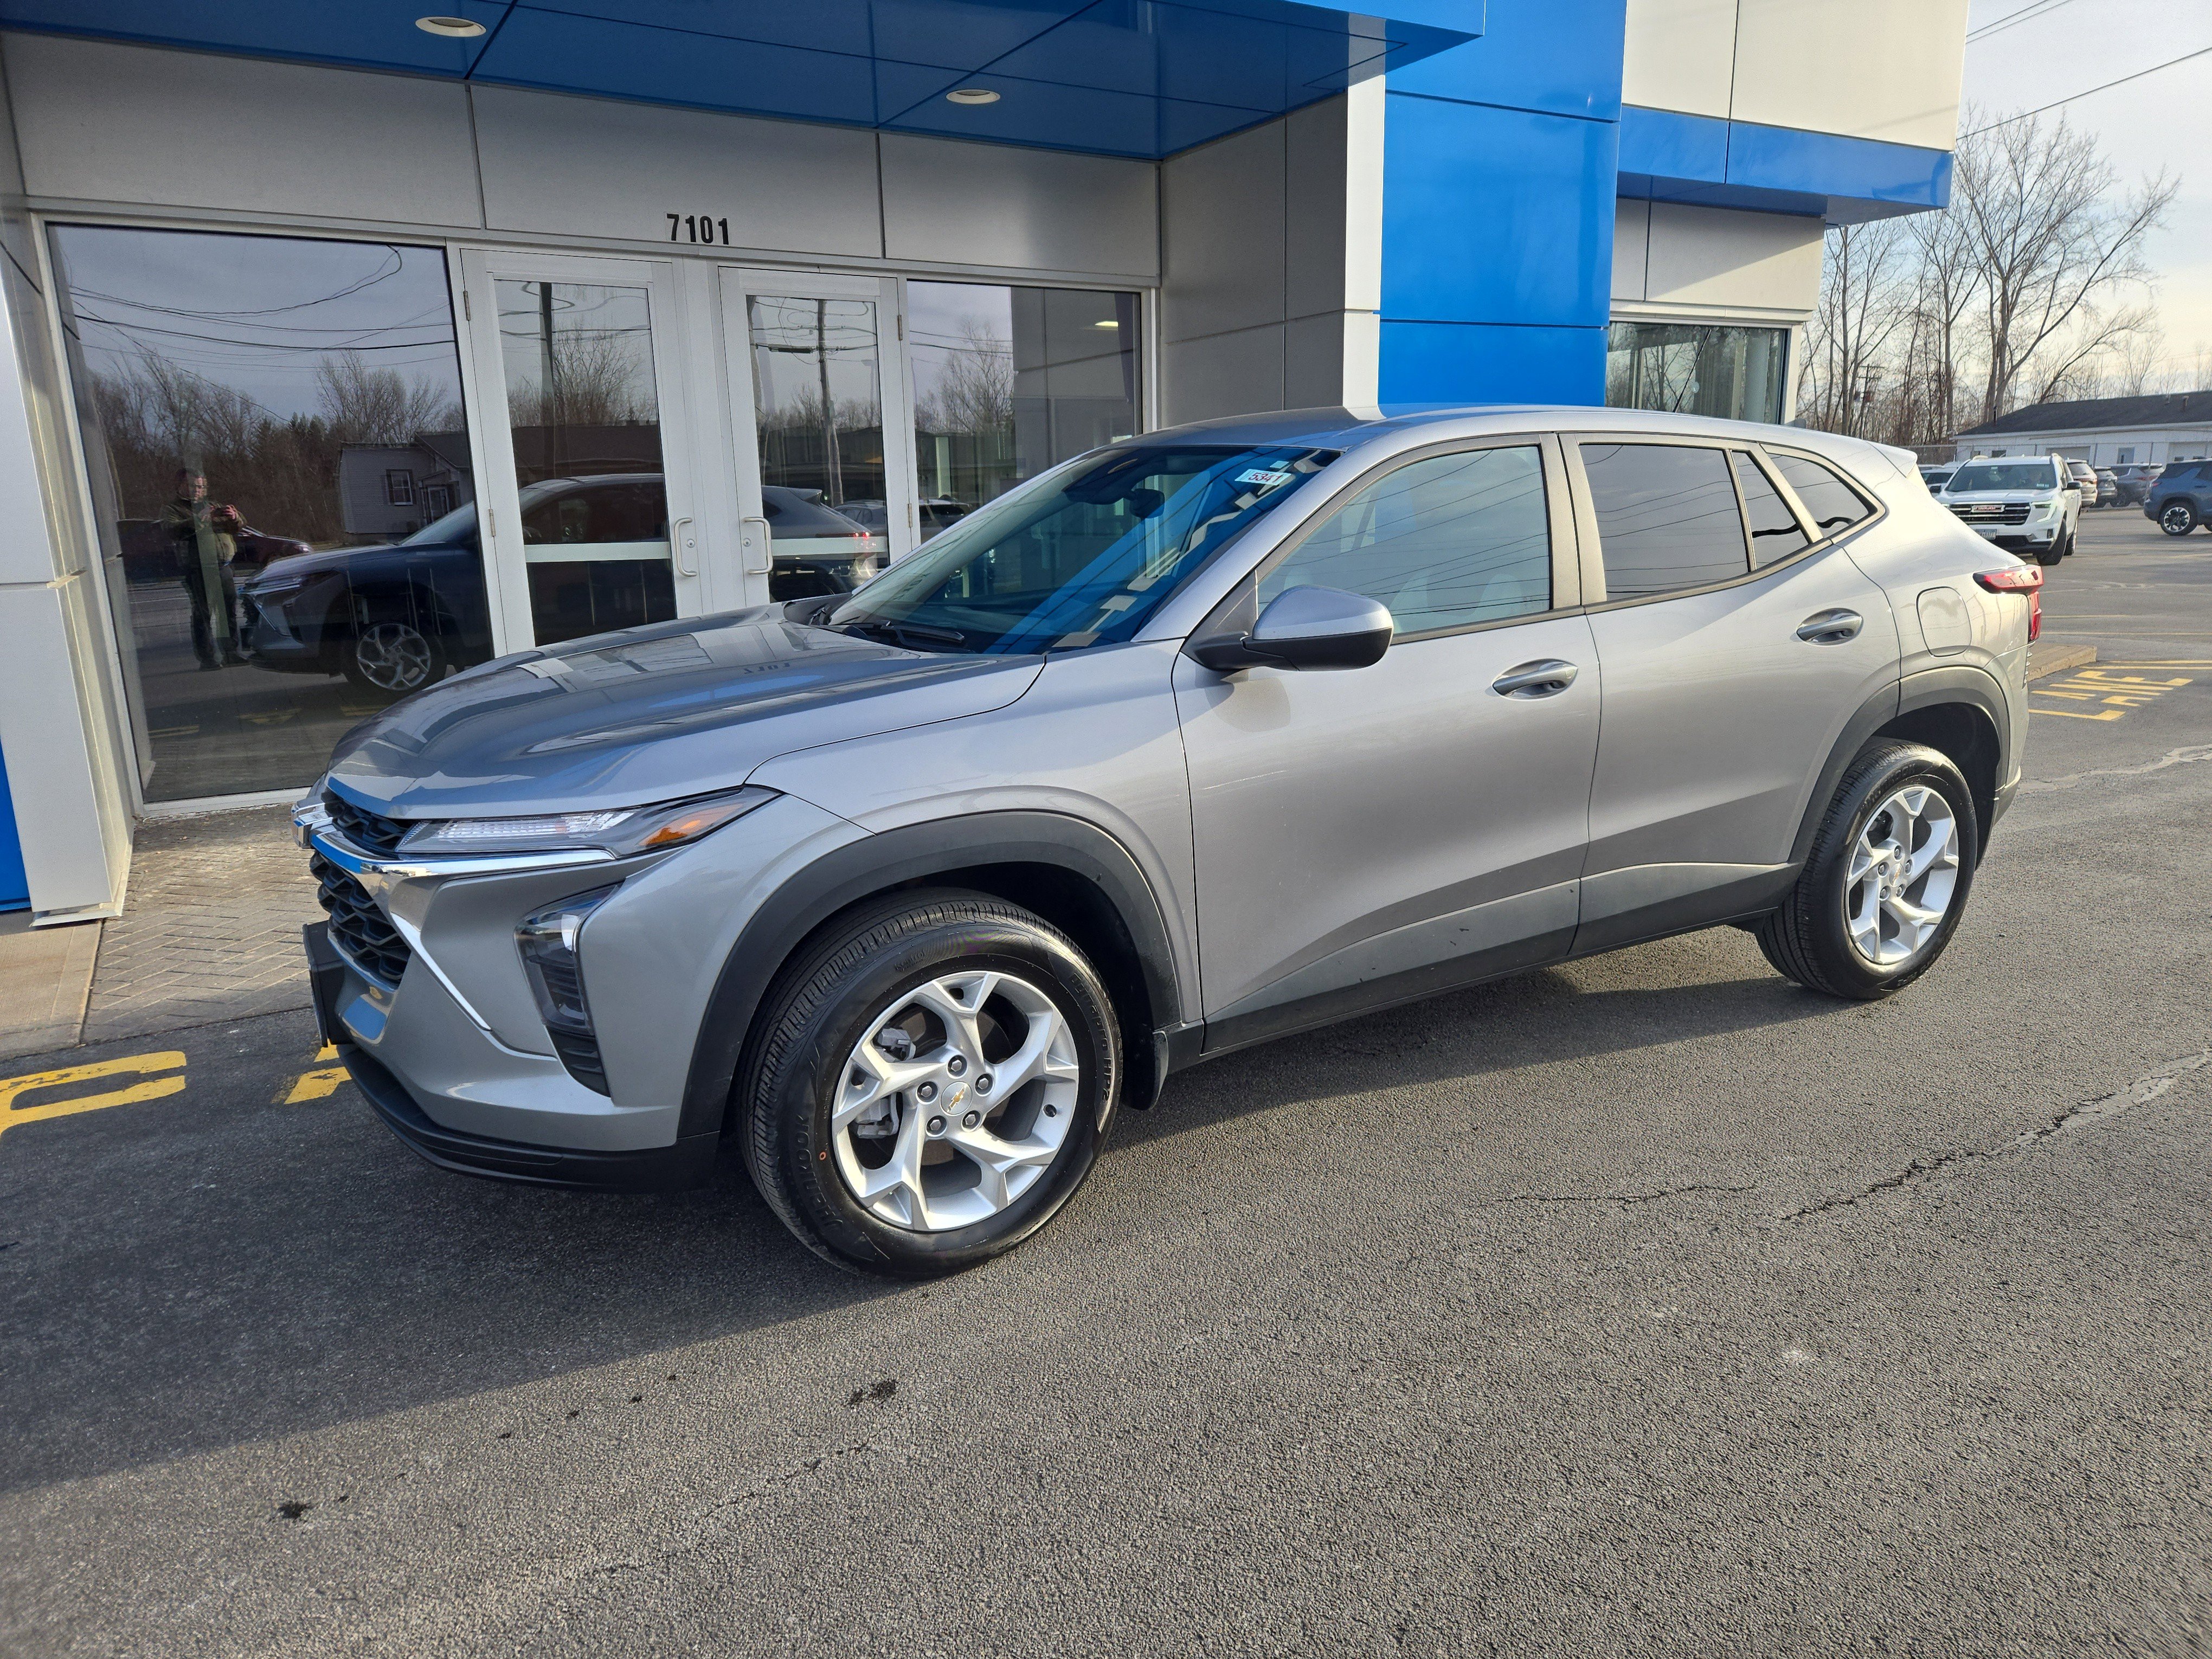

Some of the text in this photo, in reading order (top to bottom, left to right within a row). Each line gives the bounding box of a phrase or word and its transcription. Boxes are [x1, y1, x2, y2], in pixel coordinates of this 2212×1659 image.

[666, 213, 729, 245] 7101
[1248, 472, 1283, 483] 5341
[2028, 670, 2194, 722] LANE
